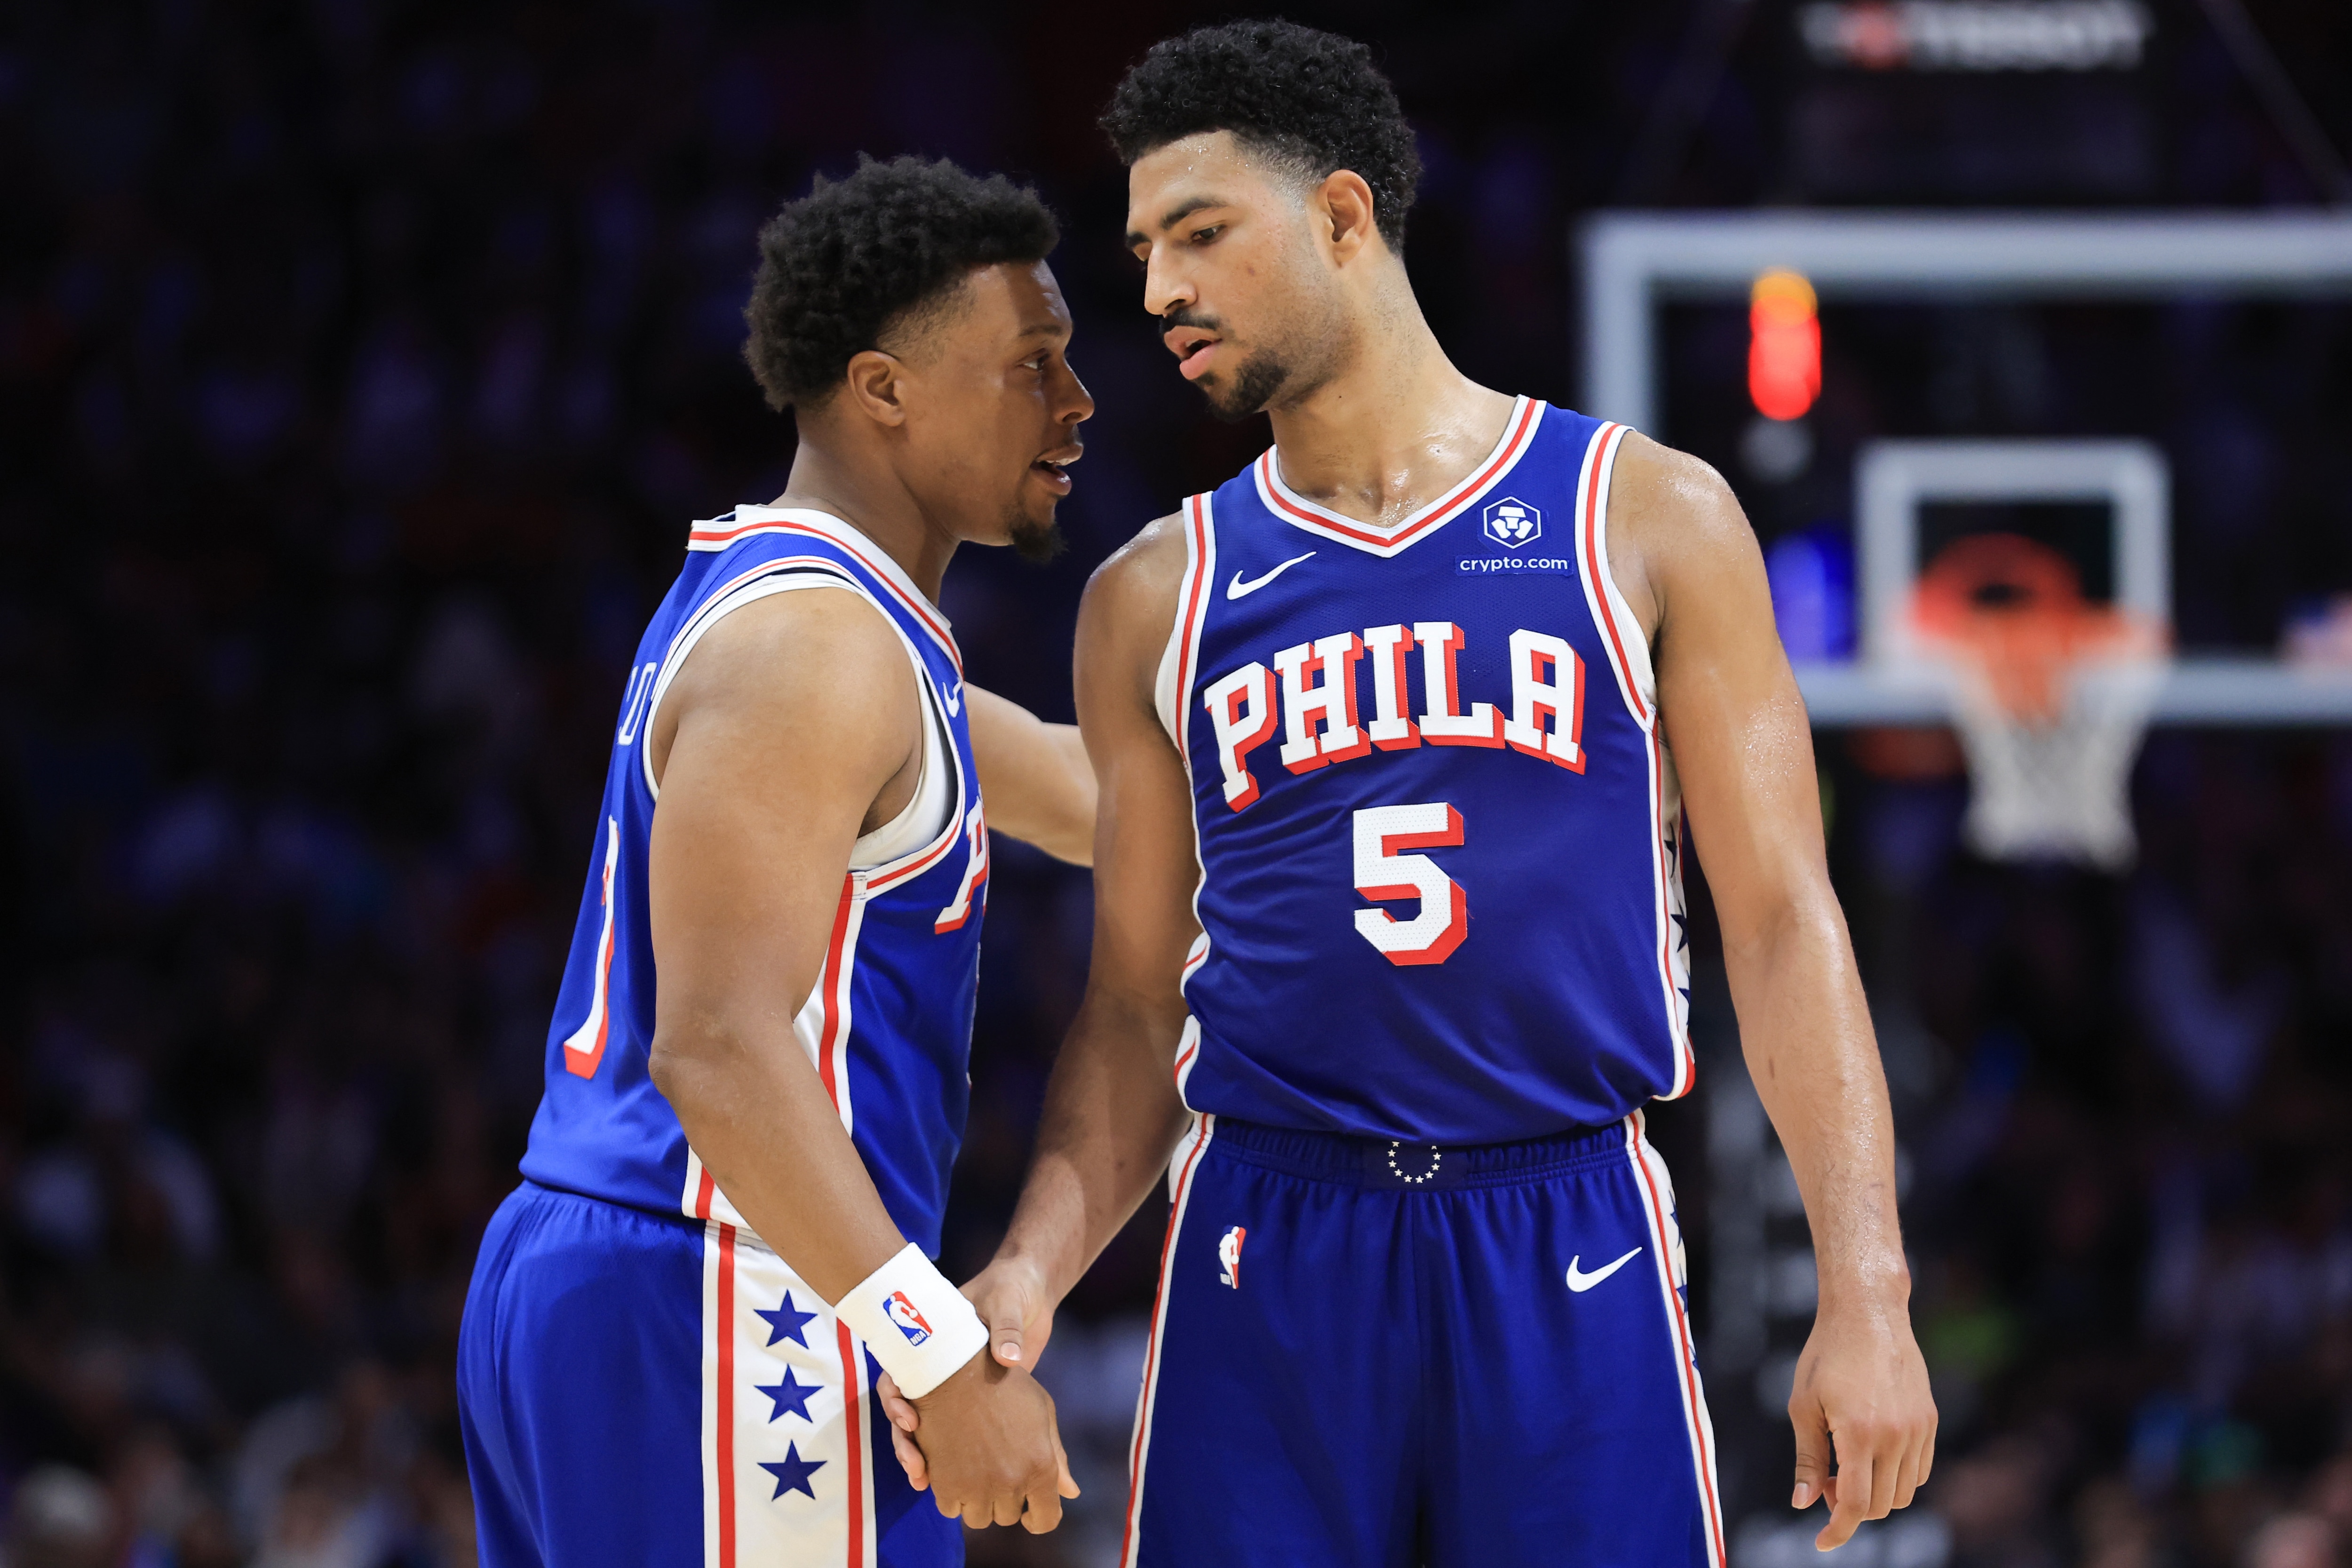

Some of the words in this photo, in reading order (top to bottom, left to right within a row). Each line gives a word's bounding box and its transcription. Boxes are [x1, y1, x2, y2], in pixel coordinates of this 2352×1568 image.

[1460, 556, 1568, 572] crypto.com
[1204, 621, 1587, 813] PHILA
[1353, 802, 1468, 966] 5
[909, 1330, 927, 1345] NBA
